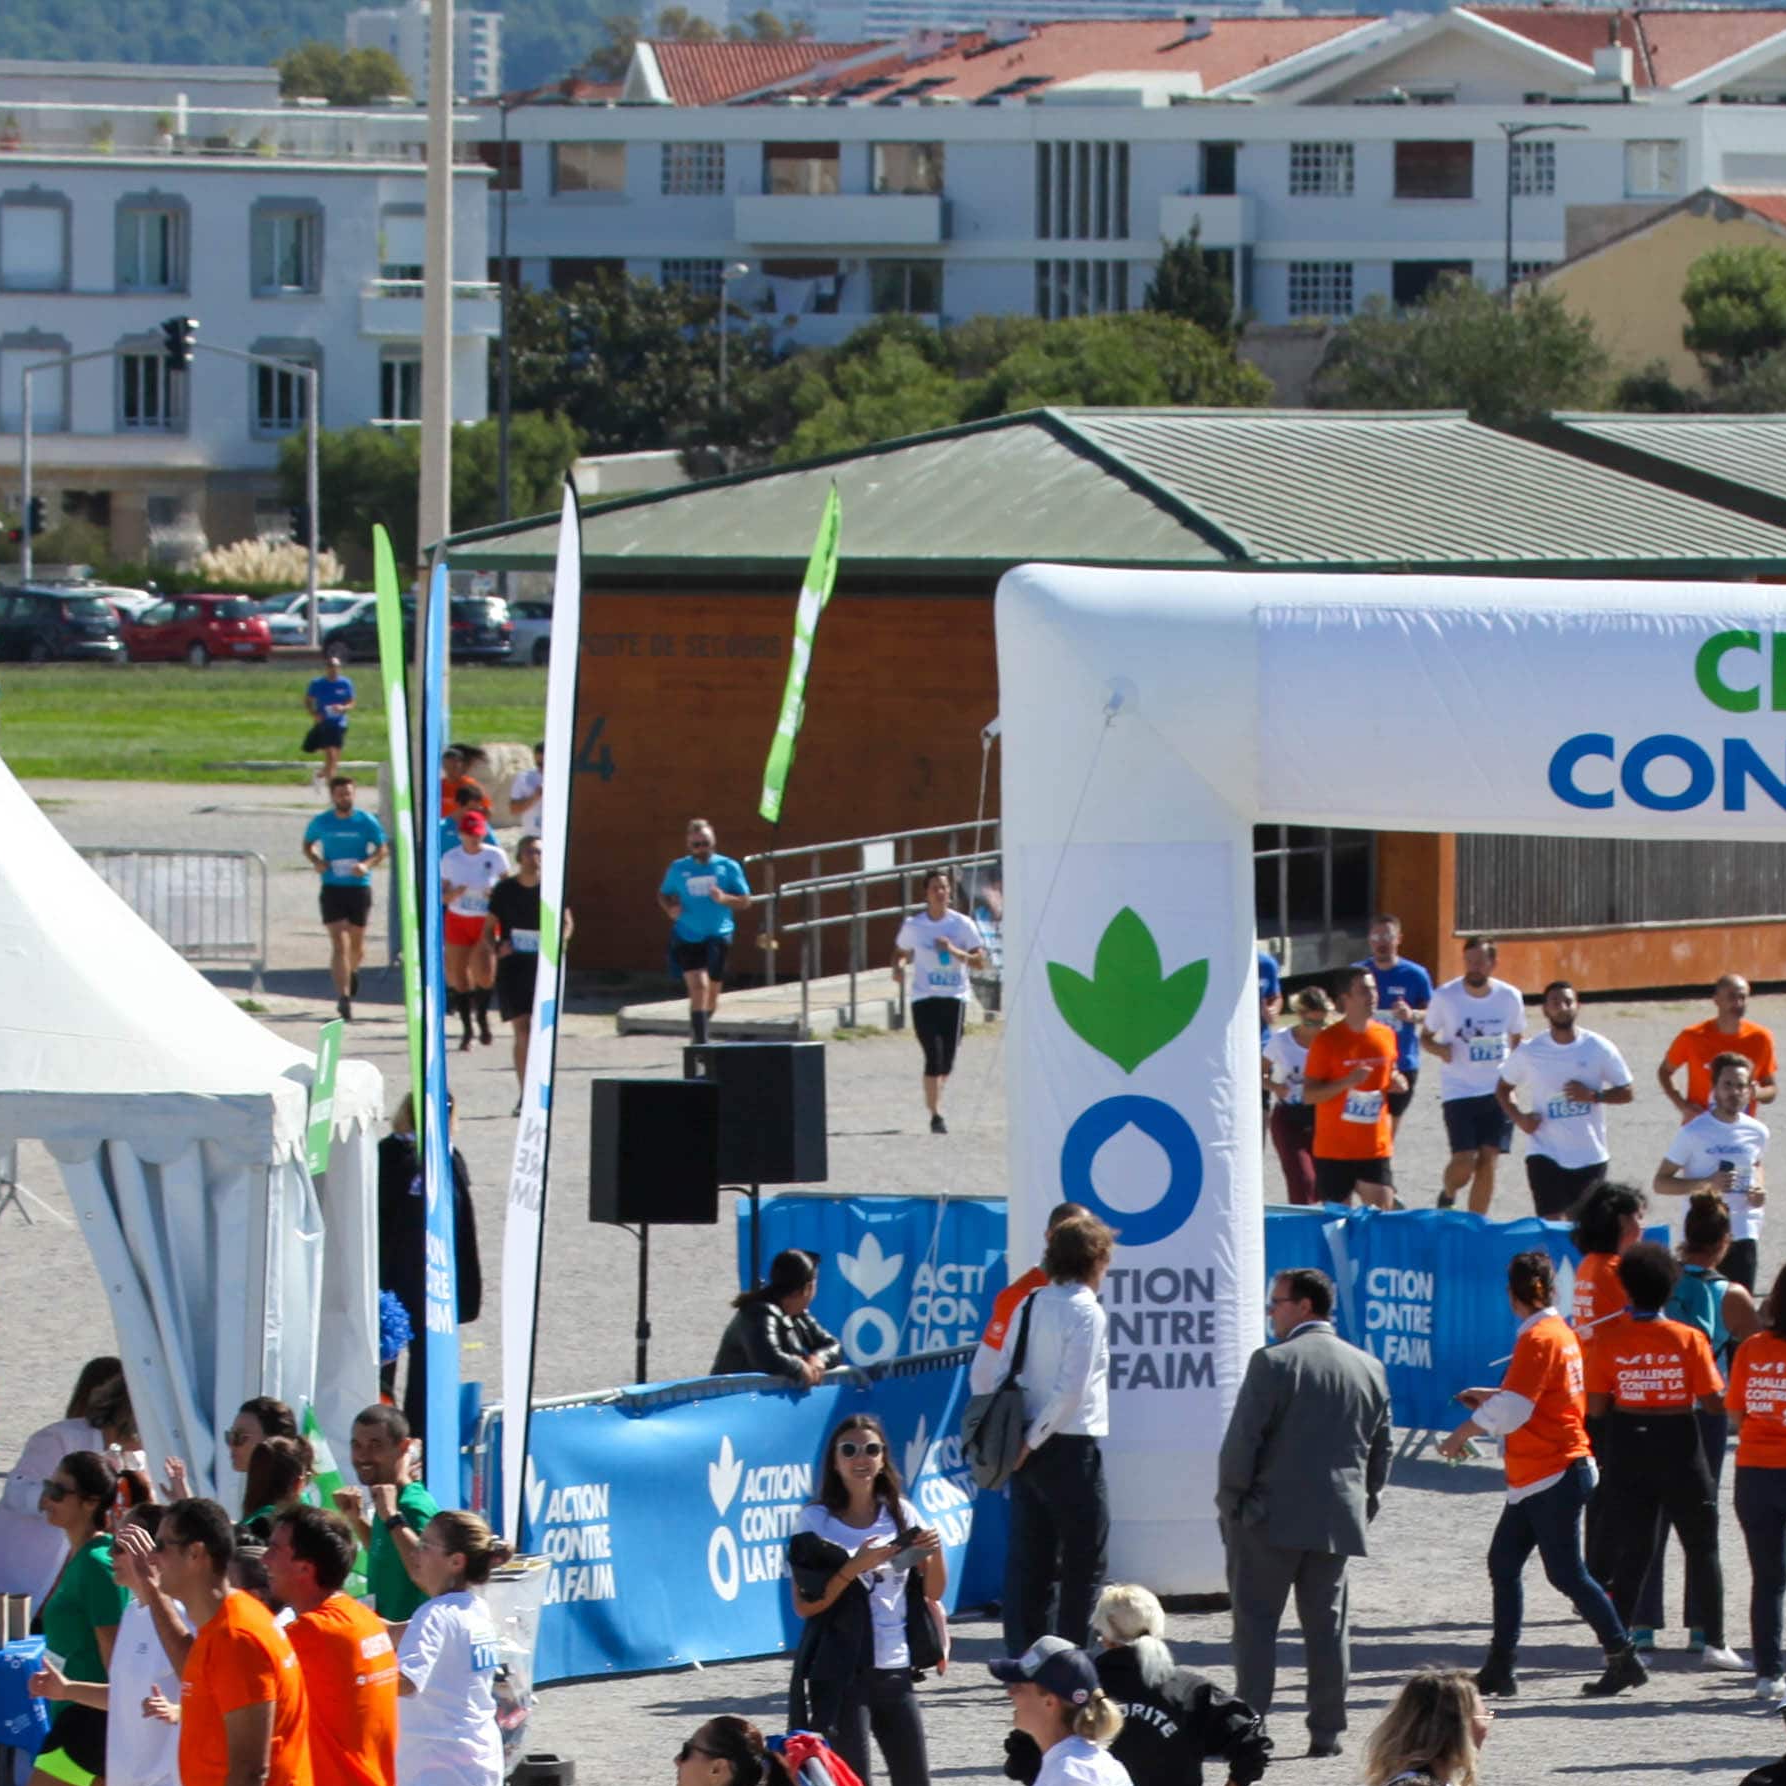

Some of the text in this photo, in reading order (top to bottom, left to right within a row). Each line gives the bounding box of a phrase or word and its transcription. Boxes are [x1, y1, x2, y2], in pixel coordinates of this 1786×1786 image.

[1096, 1267, 1216, 1305] TION
[1365, 1266, 1434, 1302] CTION
[911, 1294, 981, 1326] CON
[1108, 1310, 1216, 1345] NTRE
[1363, 1300, 1433, 1335] ONTRE
[1383, 1336, 1433, 1369] FAIM
[1617, 1367, 1685, 1381] CHALLENGE
[1619, 1380, 1664, 1392] CONTRE
[741, 1463, 813, 1503] ACTION
[919, 1471, 979, 1514] CONT
[544, 1482, 611, 1524] ACTION
[542, 1523, 611, 1563] CONTRE
[563, 1563, 616, 1602] FAIM
[1121, 1703, 1179, 1739] RITE
